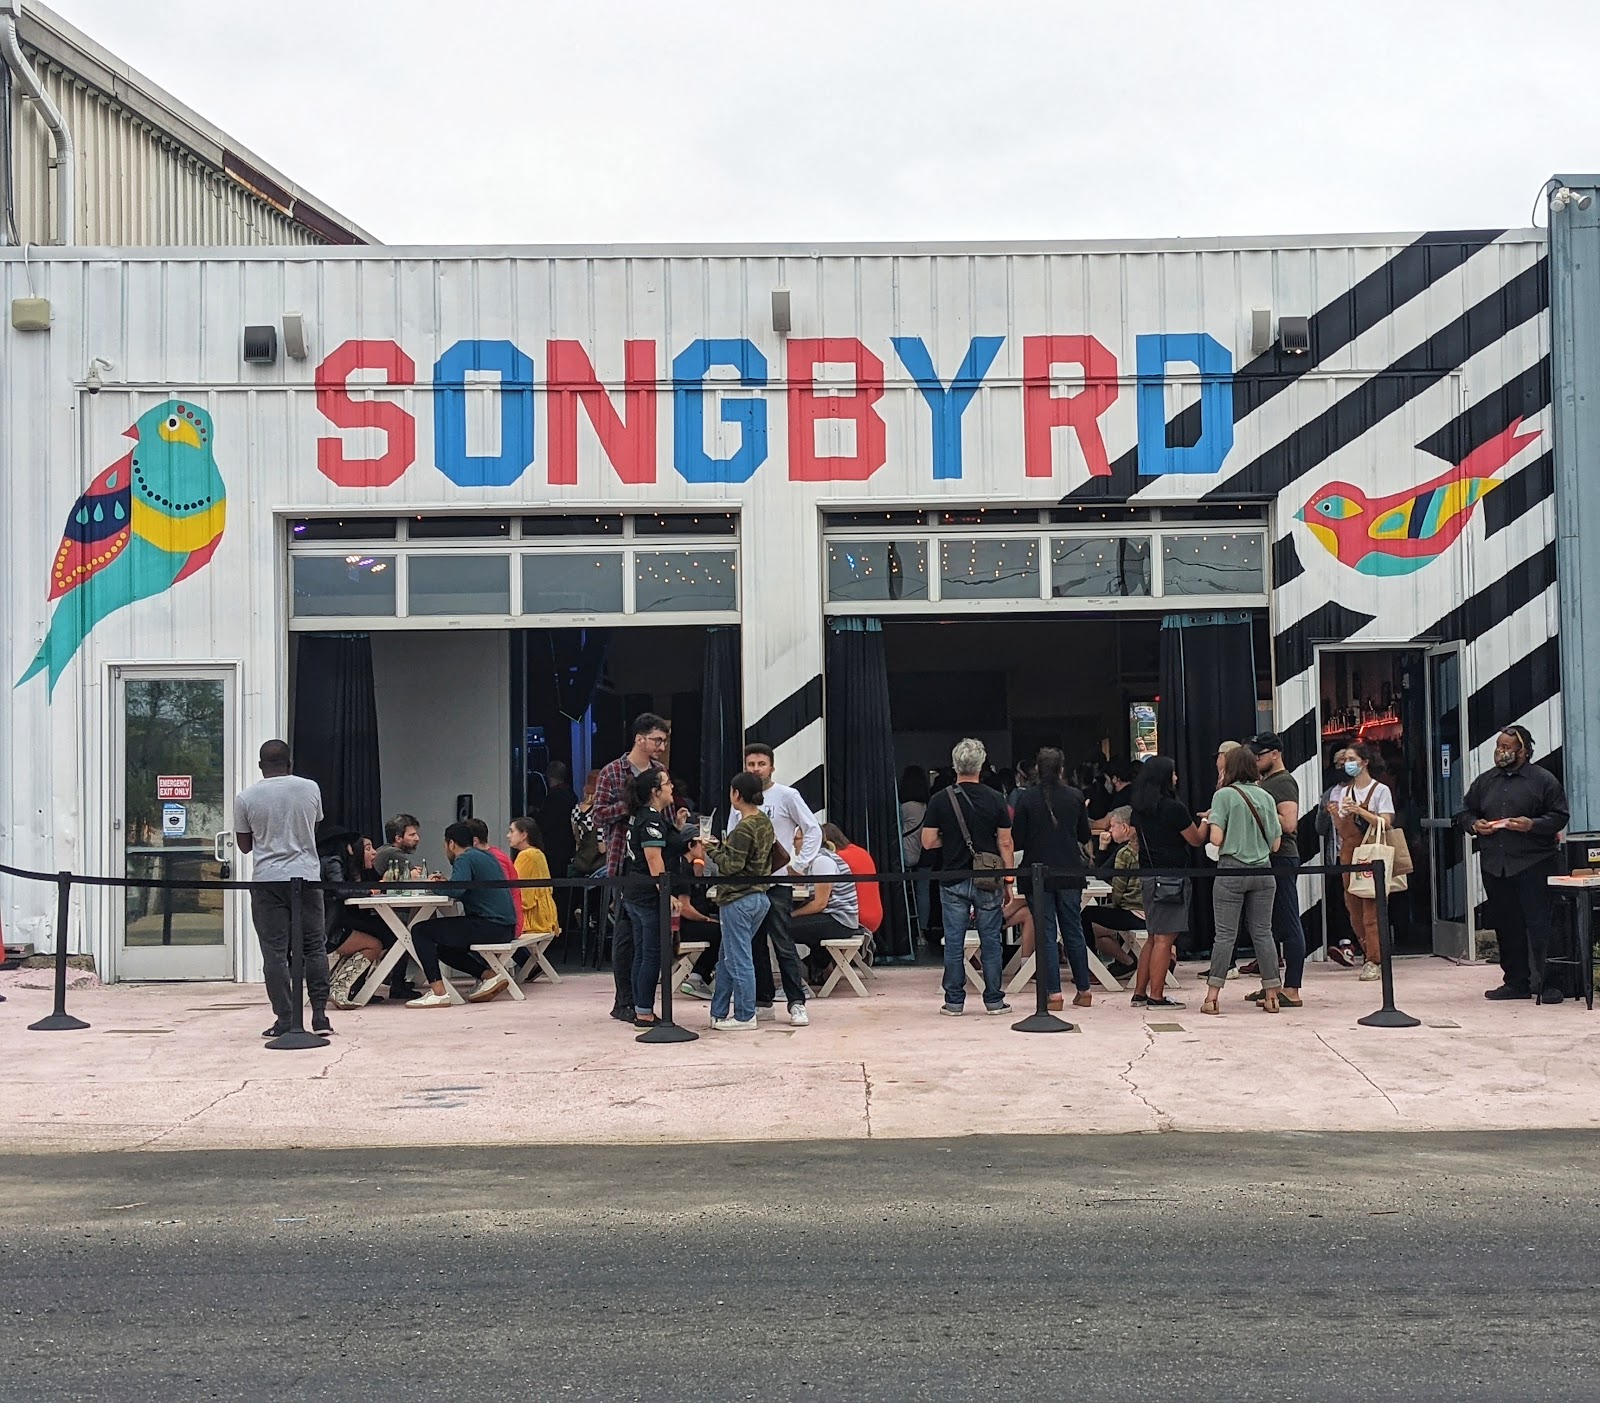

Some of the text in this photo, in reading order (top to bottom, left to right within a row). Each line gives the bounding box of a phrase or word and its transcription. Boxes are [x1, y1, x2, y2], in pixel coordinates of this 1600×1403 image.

[315, 333, 1234, 487] SONGBYRD
[159, 779, 189, 787] EMERGENCY
[159, 787, 189, 796] EXIT ONLY
